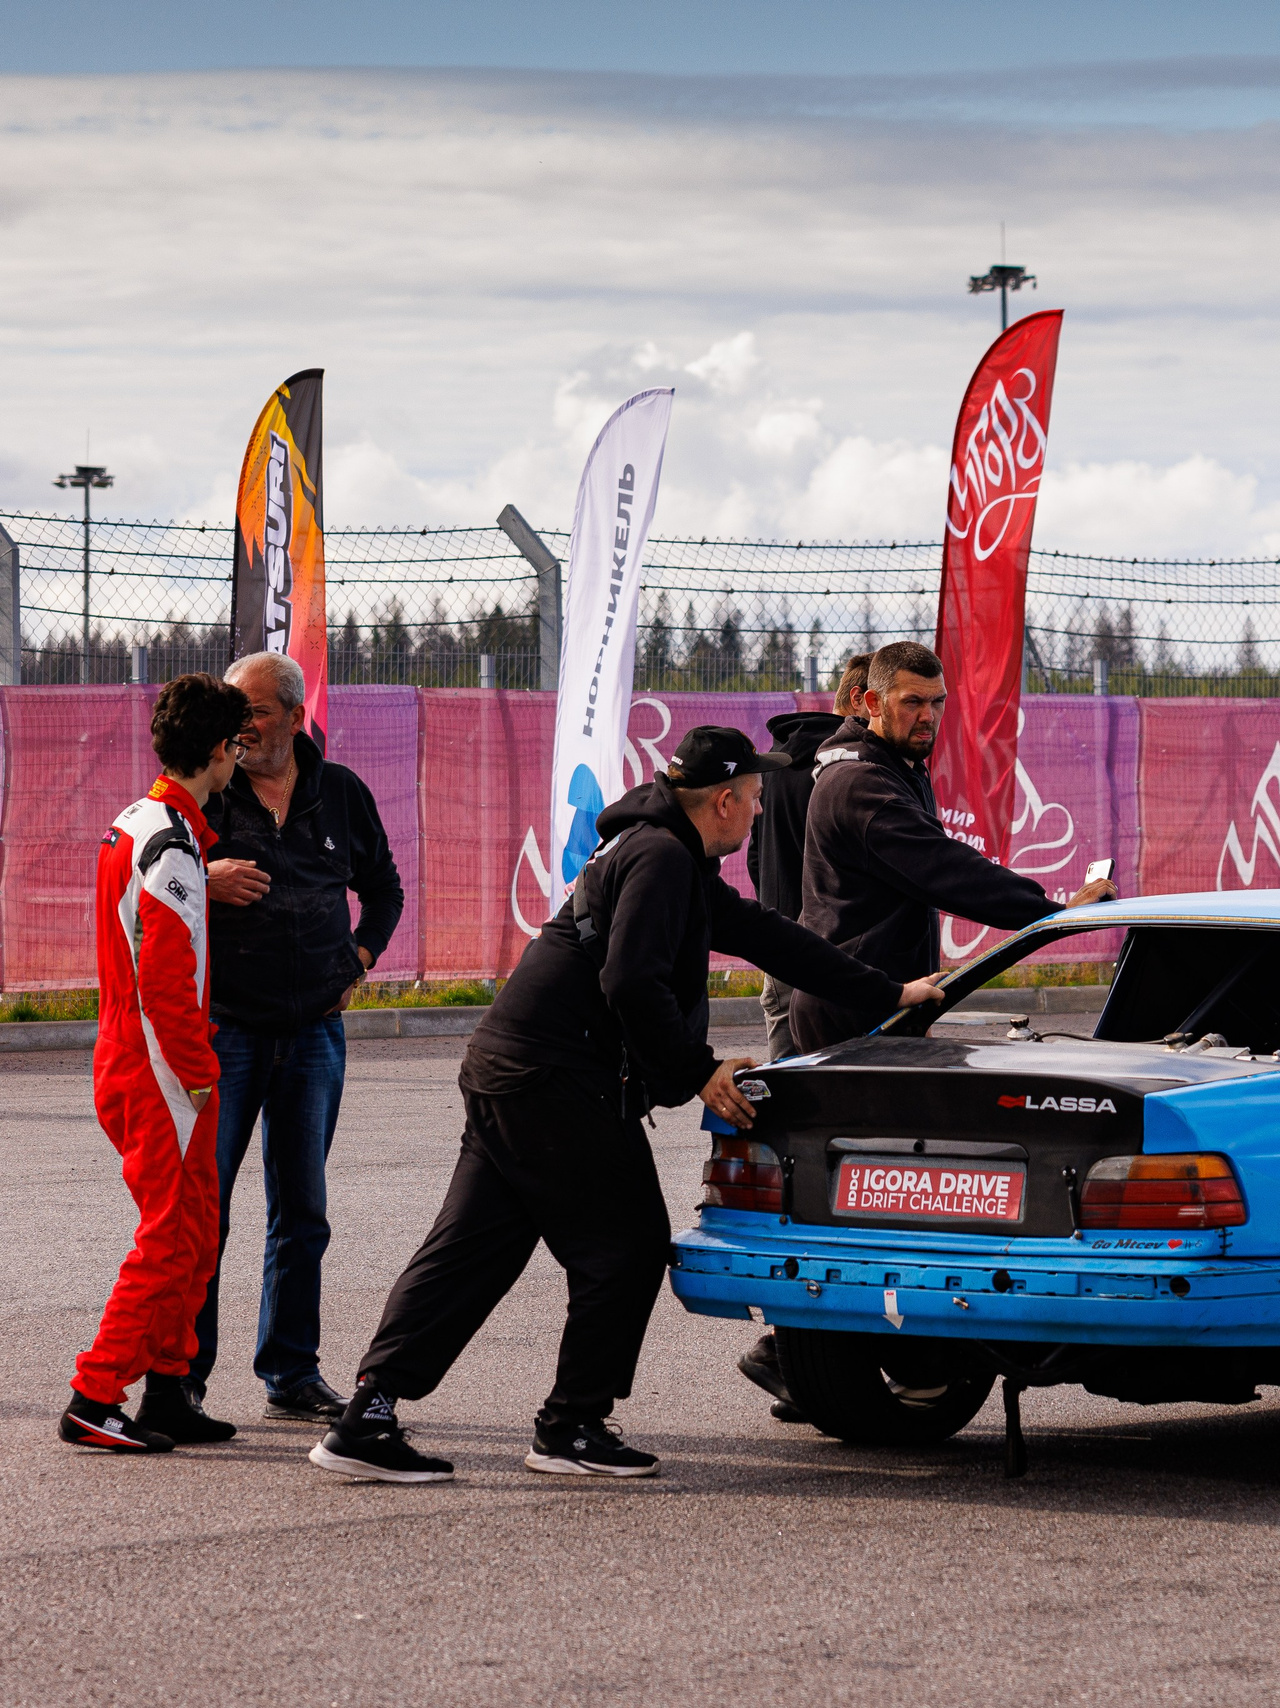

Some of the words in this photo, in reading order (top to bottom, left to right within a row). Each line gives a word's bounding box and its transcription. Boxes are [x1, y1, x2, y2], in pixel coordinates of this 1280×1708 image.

[944, 828, 986, 852] ВОИХ
[1025, 1096, 1117, 1113] LASSA
[848, 1169, 860, 1207] IDDC
[862, 1169, 933, 1193] IGORA
[939, 1173, 1011, 1197] DRIVE
[861, 1192, 907, 1209] DRIFT
[909, 1194, 1007, 1215] CHALLENGE
[105, 1419, 123, 1429] OMP
